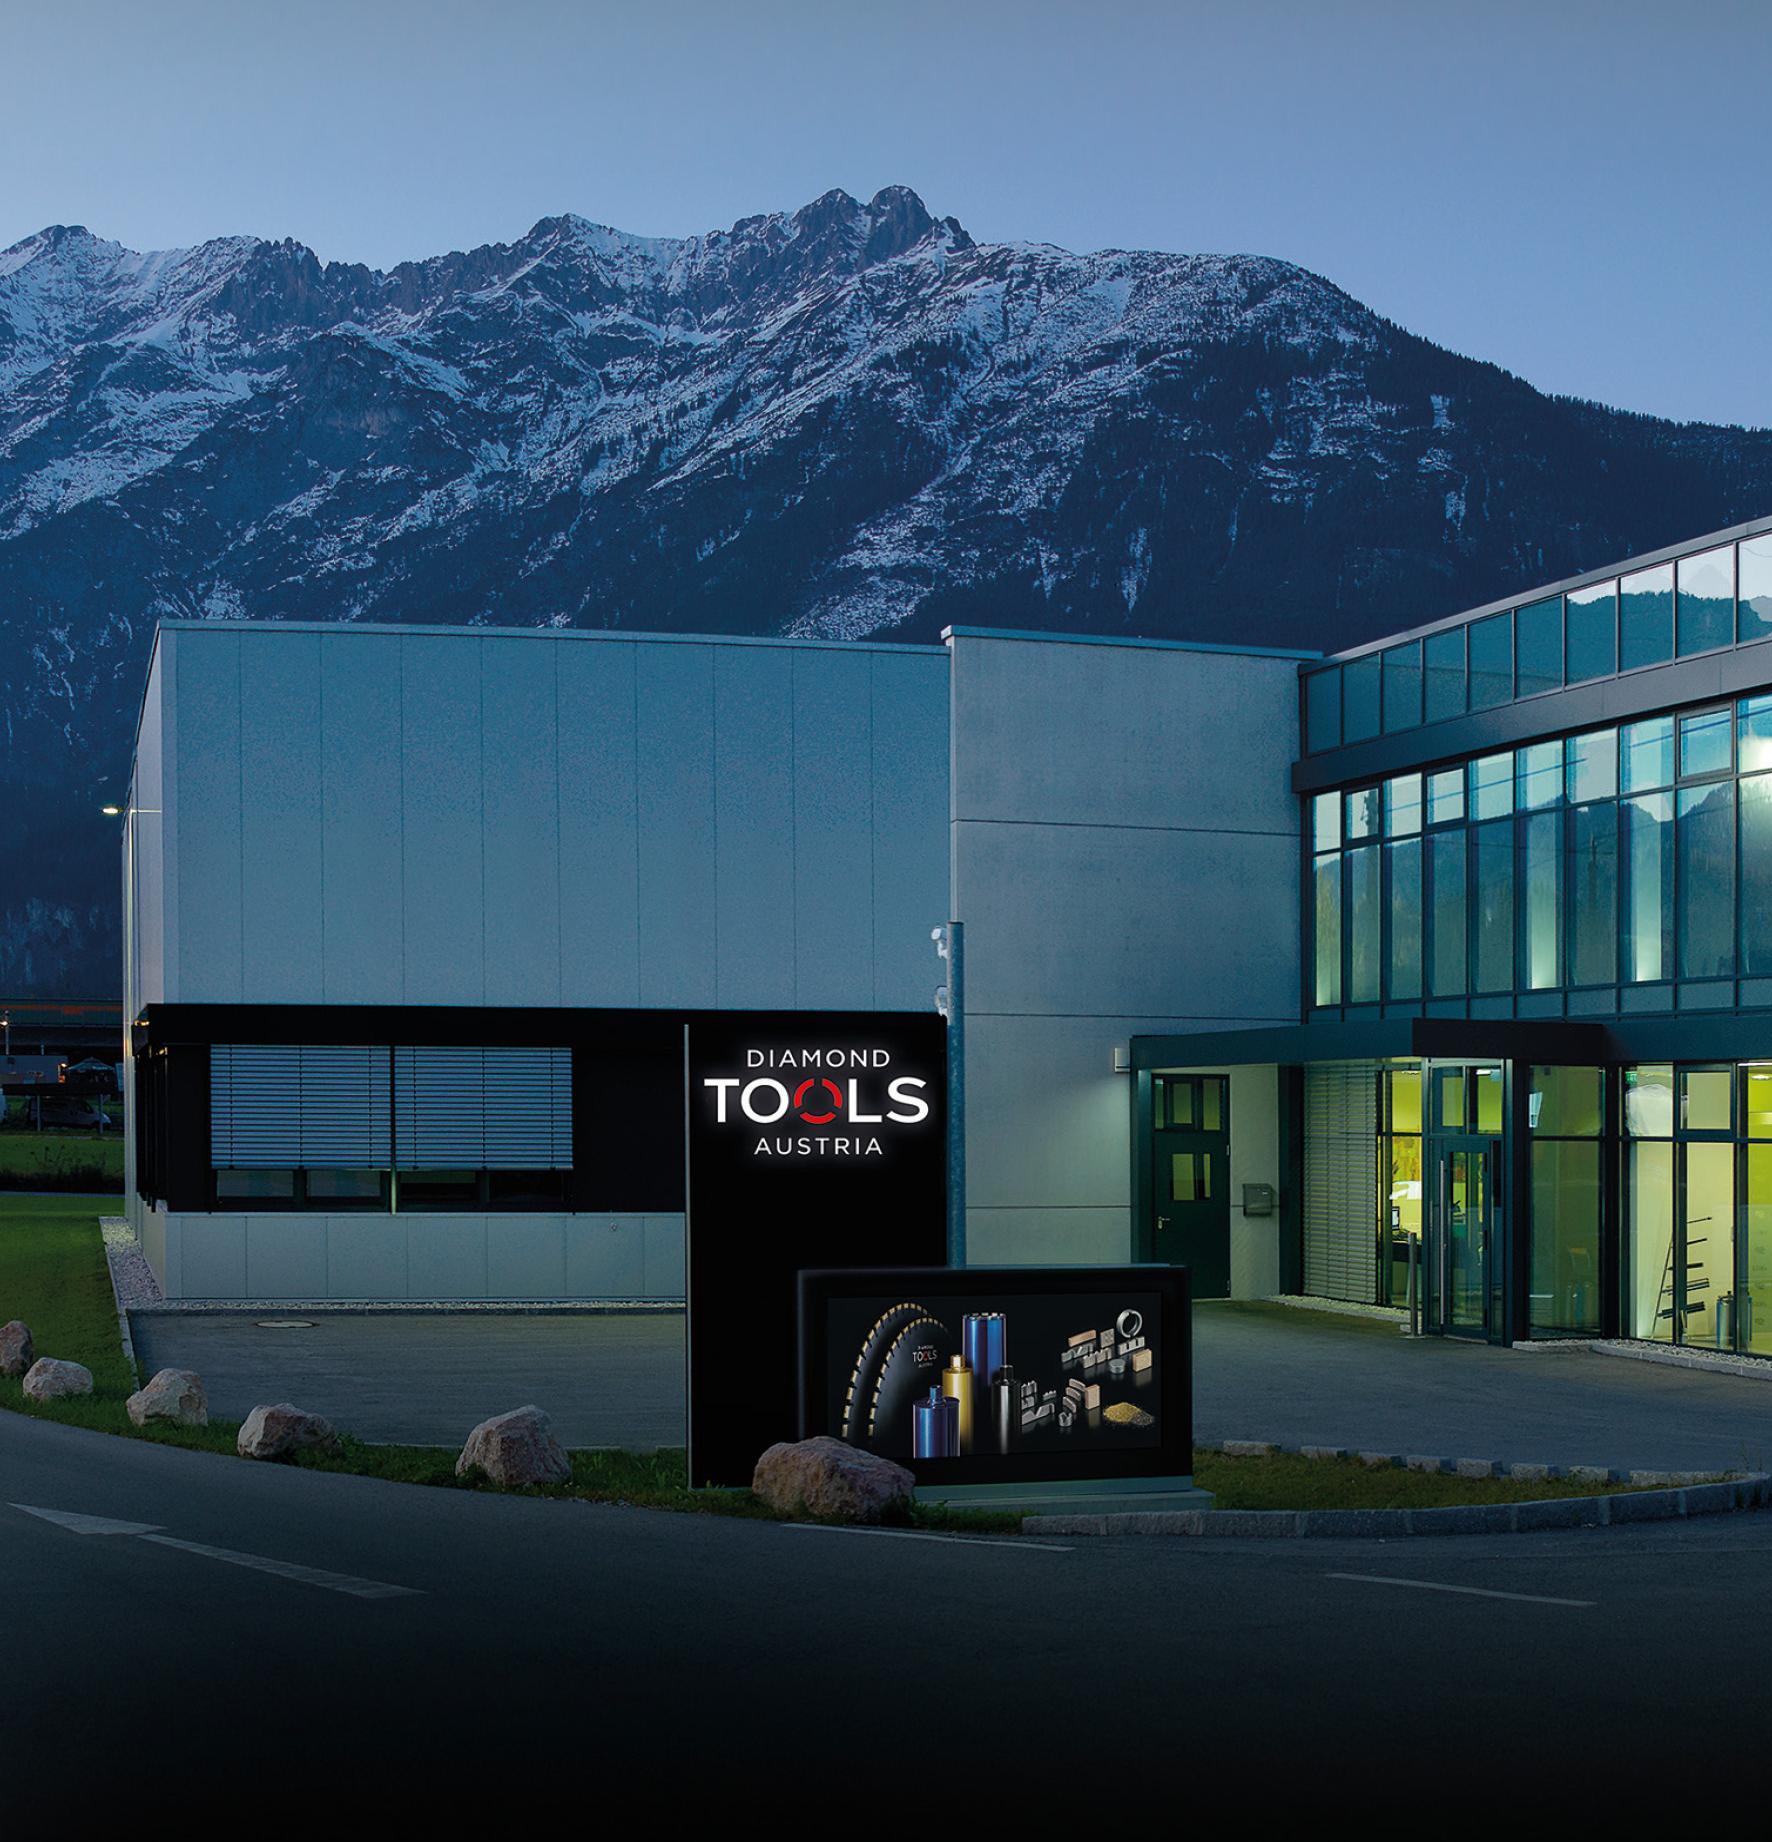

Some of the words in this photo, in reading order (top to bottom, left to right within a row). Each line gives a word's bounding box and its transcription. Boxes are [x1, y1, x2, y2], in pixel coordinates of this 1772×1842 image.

[747, 1049, 890, 1068] DIAMOND
[703, 1076, 929, 1125] TOOLS
[753, 1137, 883, 1155] AUSTRIA
